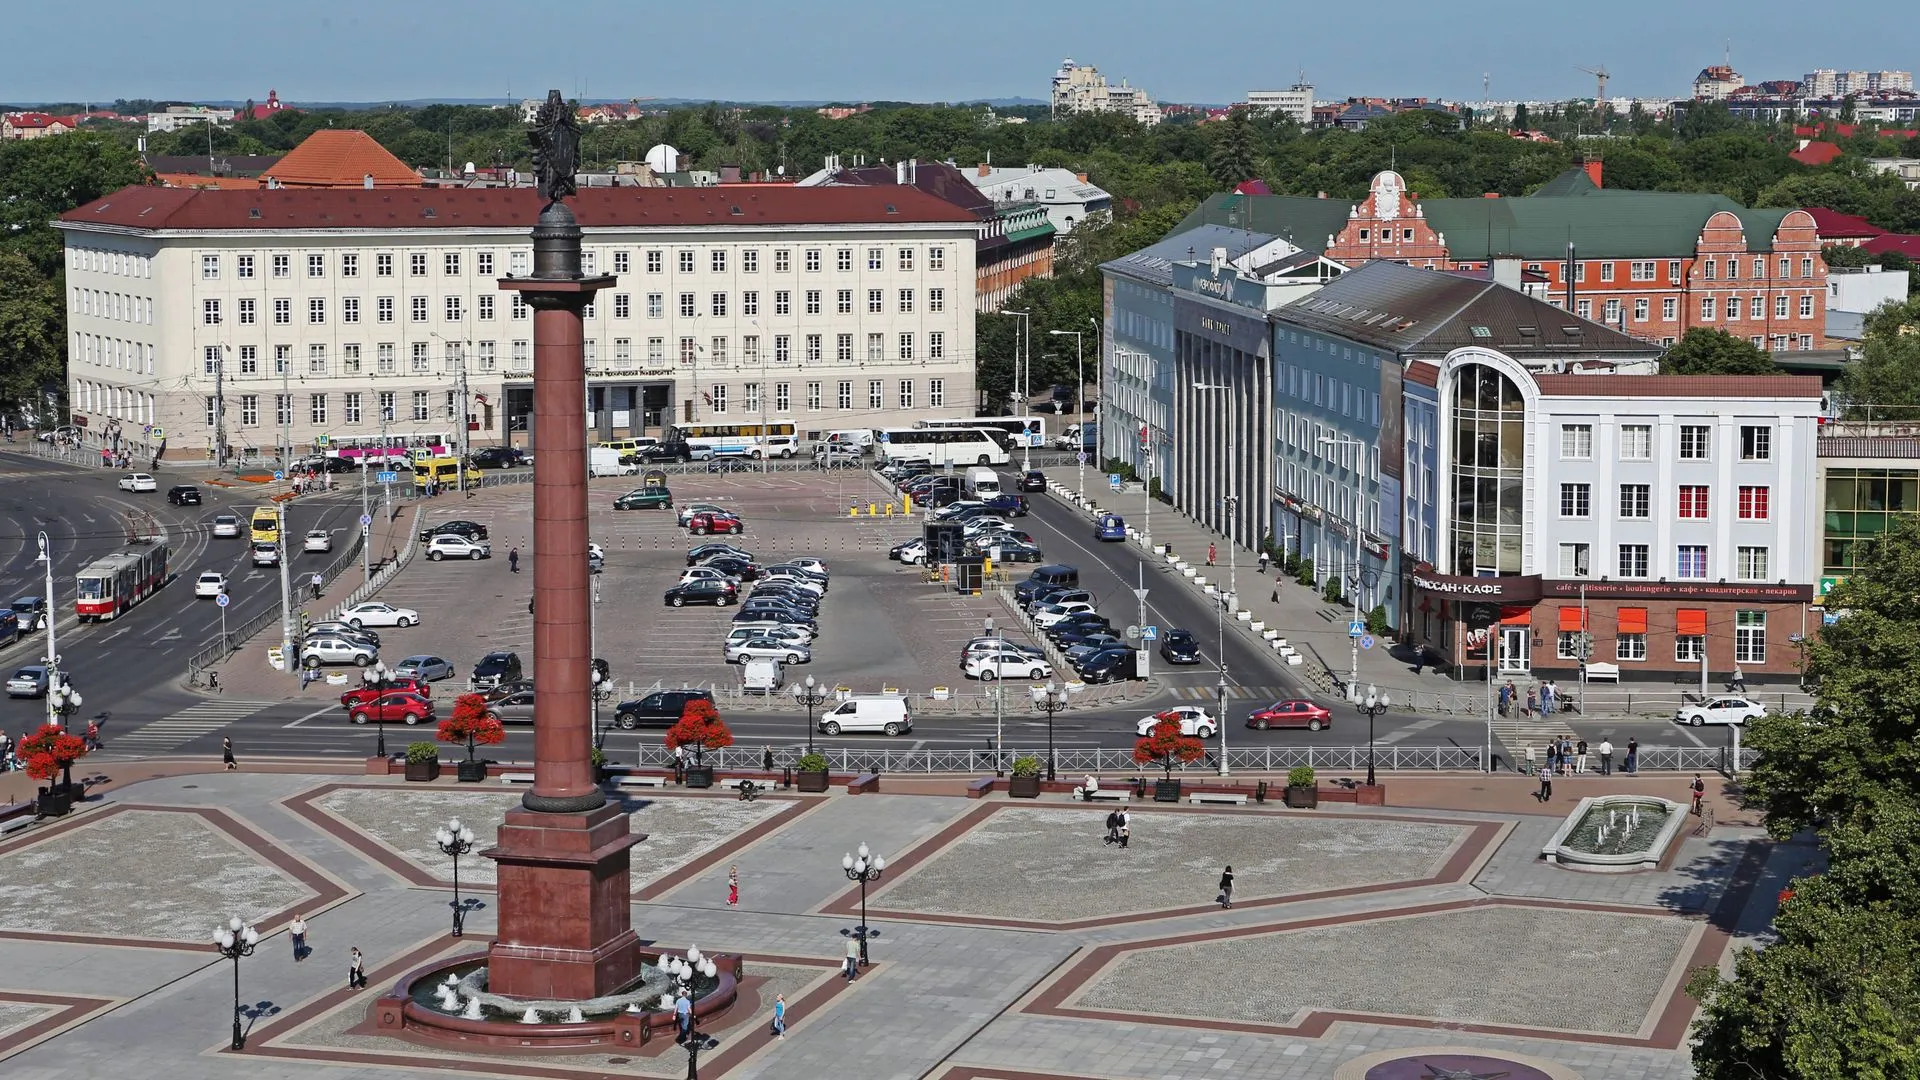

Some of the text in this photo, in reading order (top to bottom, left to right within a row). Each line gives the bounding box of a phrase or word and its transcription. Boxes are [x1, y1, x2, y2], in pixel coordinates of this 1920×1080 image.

[1462, 584, 1502, 594] КАФЕ
[1556, 583, 1572, 591] café
[1625, 585, 1671, 594] boulangerie
[1679, 586, 1698, 594] кафе
